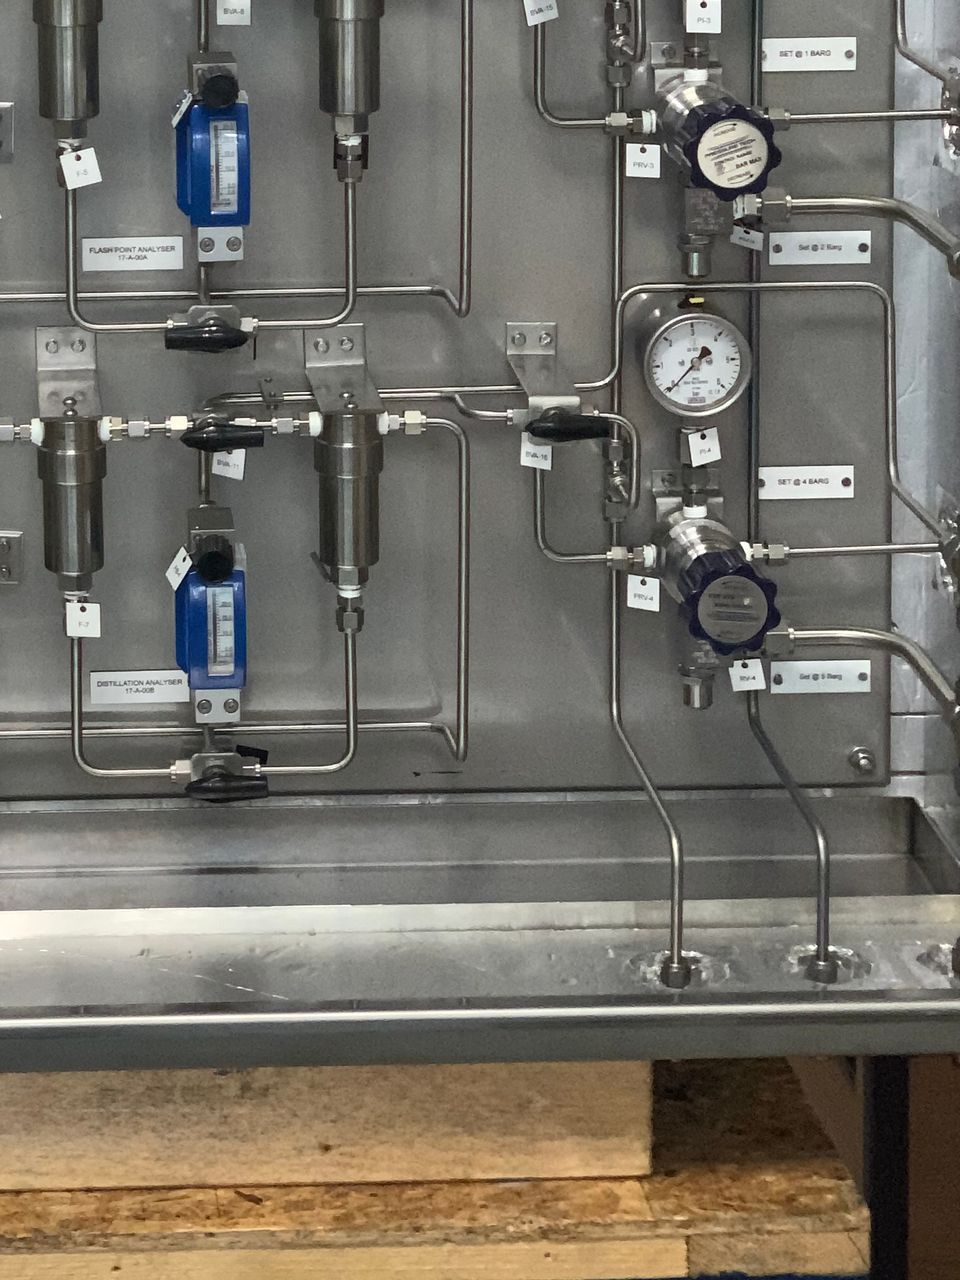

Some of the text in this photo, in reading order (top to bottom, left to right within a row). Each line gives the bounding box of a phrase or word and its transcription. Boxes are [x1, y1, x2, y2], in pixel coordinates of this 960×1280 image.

[795, 50, 803, 58] @
[811, 244, 819, 252] @
[827, 243, 843, 252] Barg
[793, 478, 801, 486] @
[633, 593, 654, 601] PRV-4
[811, 673, 819, 681] @
[827, 673, 843, 681] Barg
[145, 678, 183, 686] ANALYSER
